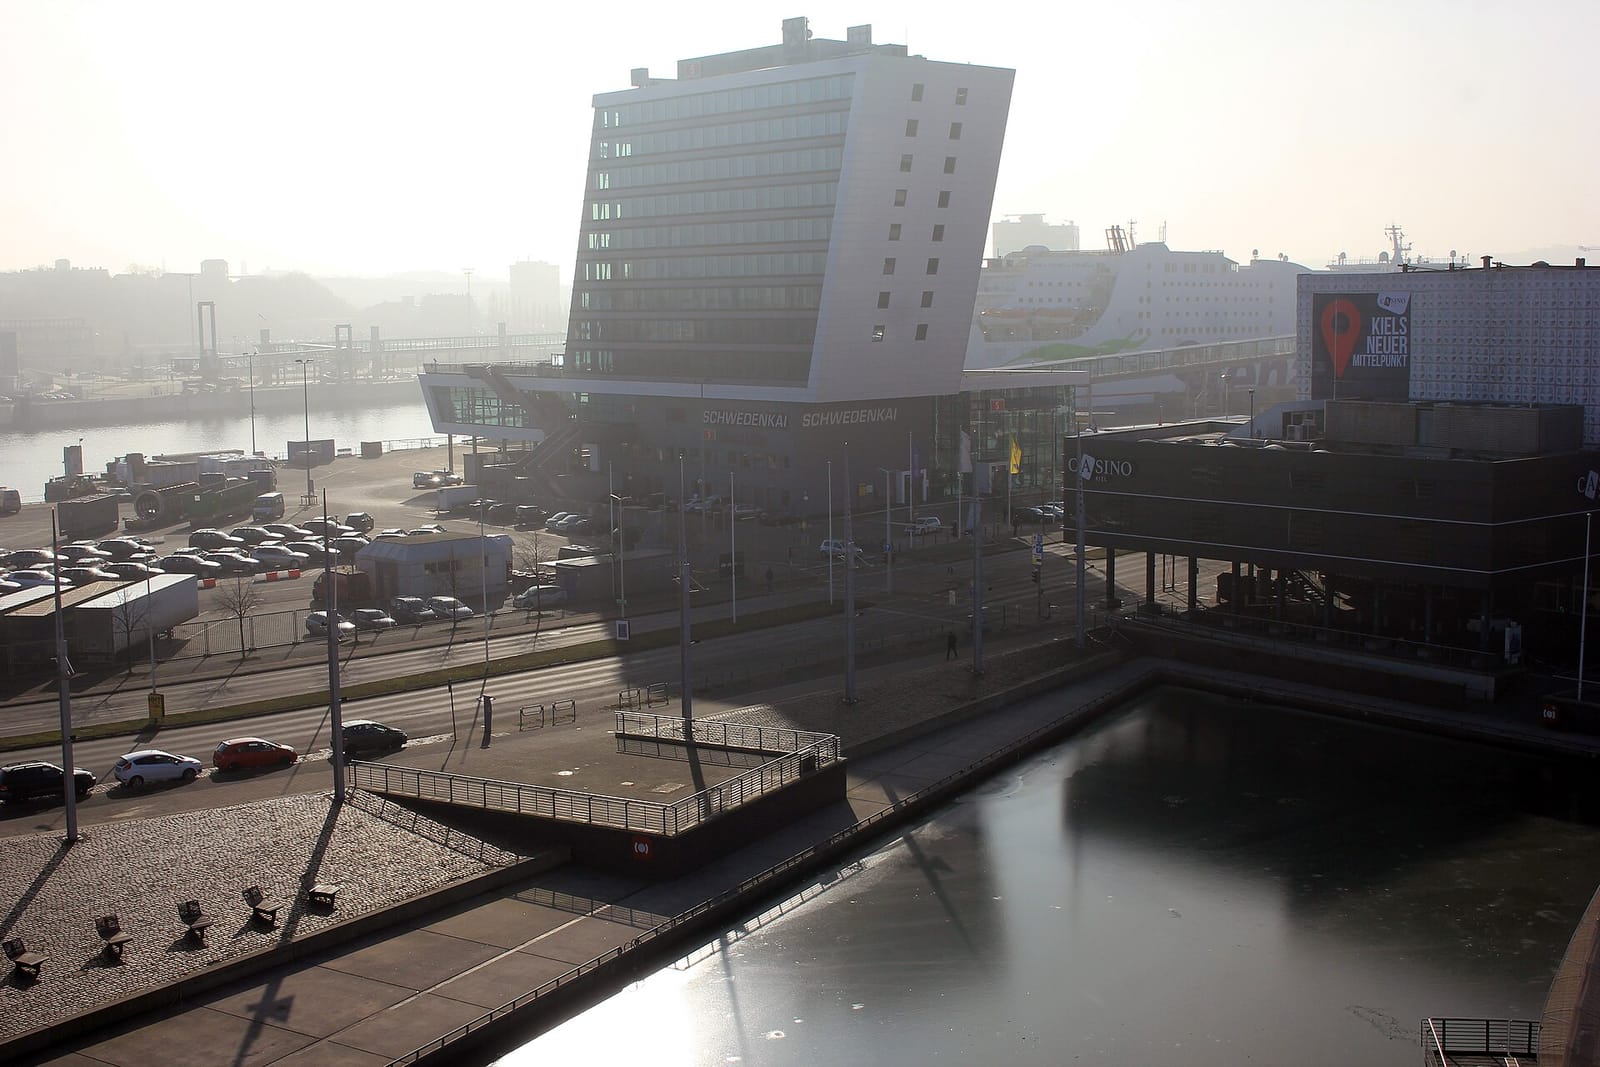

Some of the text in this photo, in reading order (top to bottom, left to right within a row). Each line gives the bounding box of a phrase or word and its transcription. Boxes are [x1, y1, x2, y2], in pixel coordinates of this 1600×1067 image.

[1371, 317, 1407, 335] KIELS
[1366, 336, 1407, 354] NEUER
[1352, 354, 1408, 367] MITTELPUNKT
[703, 410, 787, 428] SCHWEDENKAI
[802, 408, 897, 427] SCHWEDENKAI
[1068, 456, 1133, 477] CASINO
[1577, 473, 1600, 497] CA
